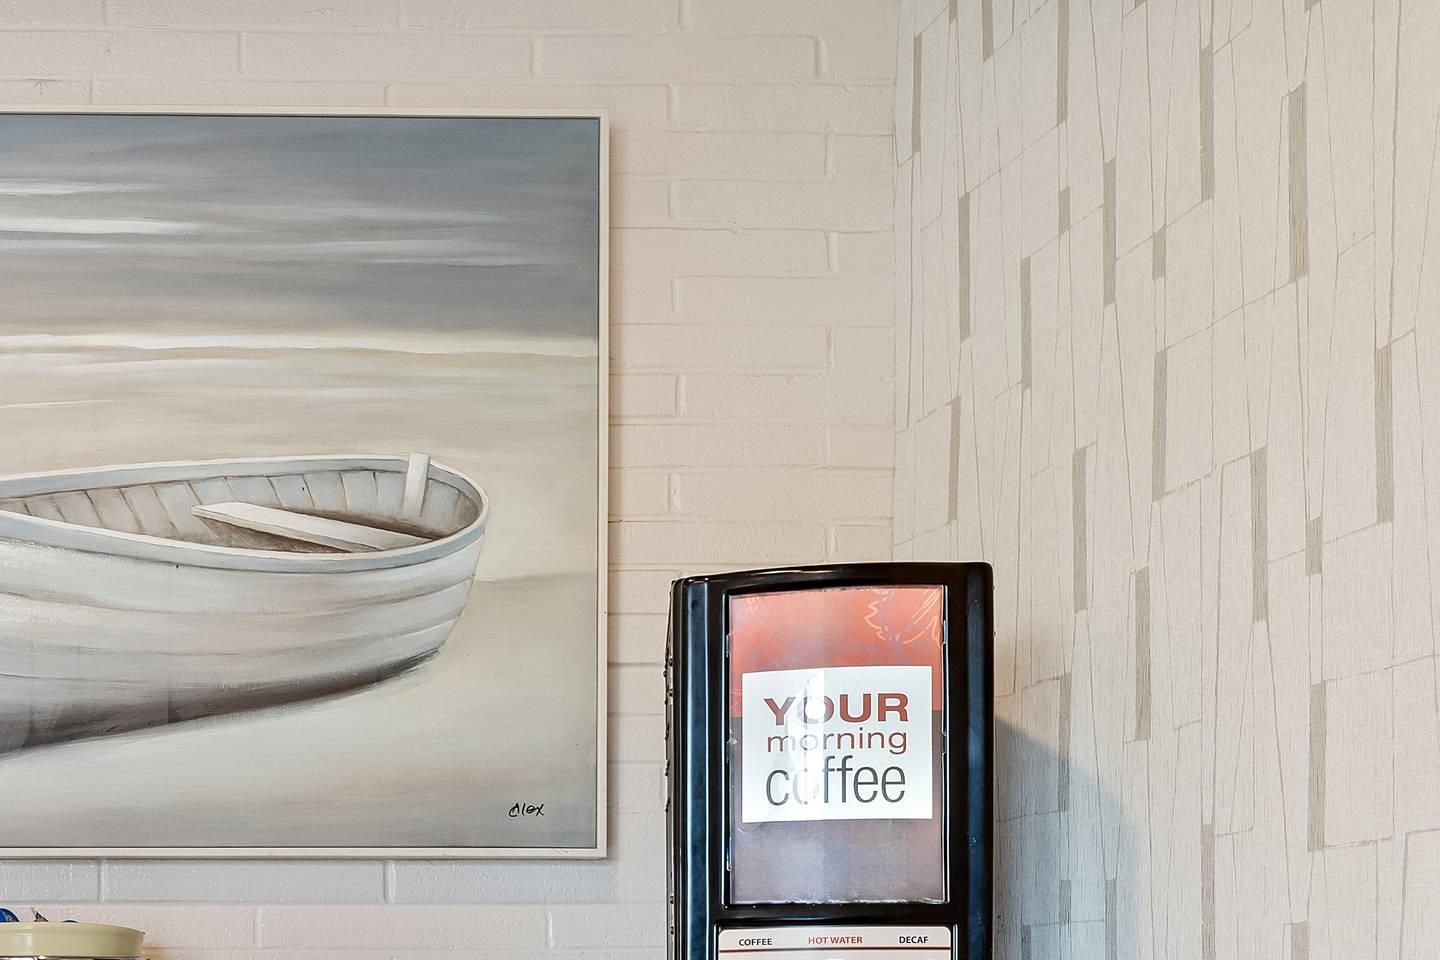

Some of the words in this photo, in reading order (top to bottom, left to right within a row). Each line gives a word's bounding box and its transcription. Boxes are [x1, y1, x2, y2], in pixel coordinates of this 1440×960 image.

[763, 692, 909, 726] YOUR
[767, 726, 908, 755] morning
[765, 754, 906, 806] coffee
[738, 937, 773, 947] COFFEE
[808, 936, 829, 945] HOT
[830, 936, 863, 945] WATER
[898, 935, 929, 944] DECAF
